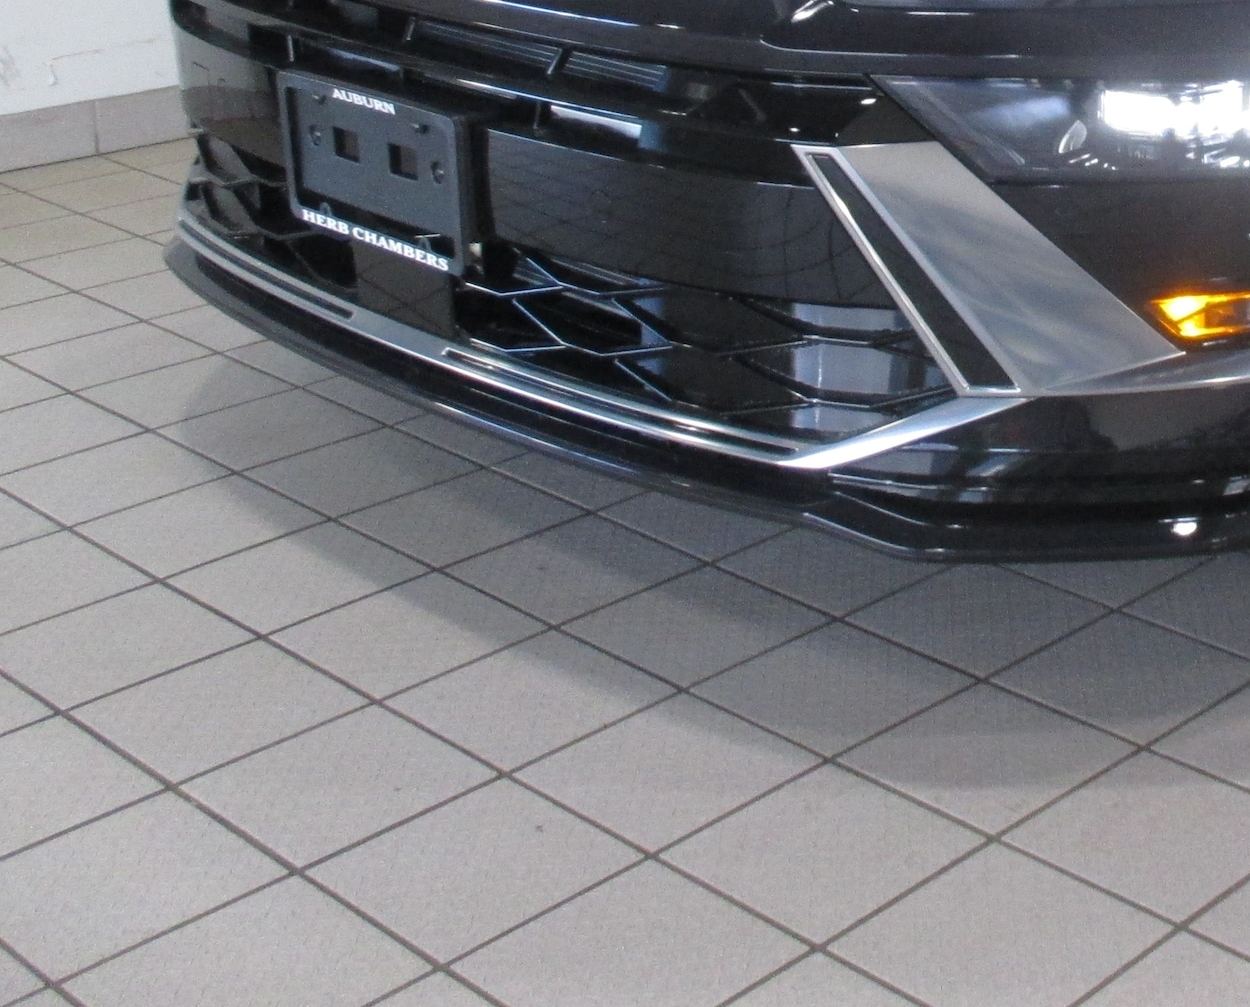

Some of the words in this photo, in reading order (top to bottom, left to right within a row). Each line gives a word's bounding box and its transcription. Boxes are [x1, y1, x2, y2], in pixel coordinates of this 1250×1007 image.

[333, 88, 396, 115] AUBURN
[302, 208, 350, 235] HERB
[352, 226, 449, 271] CHAMBERS
